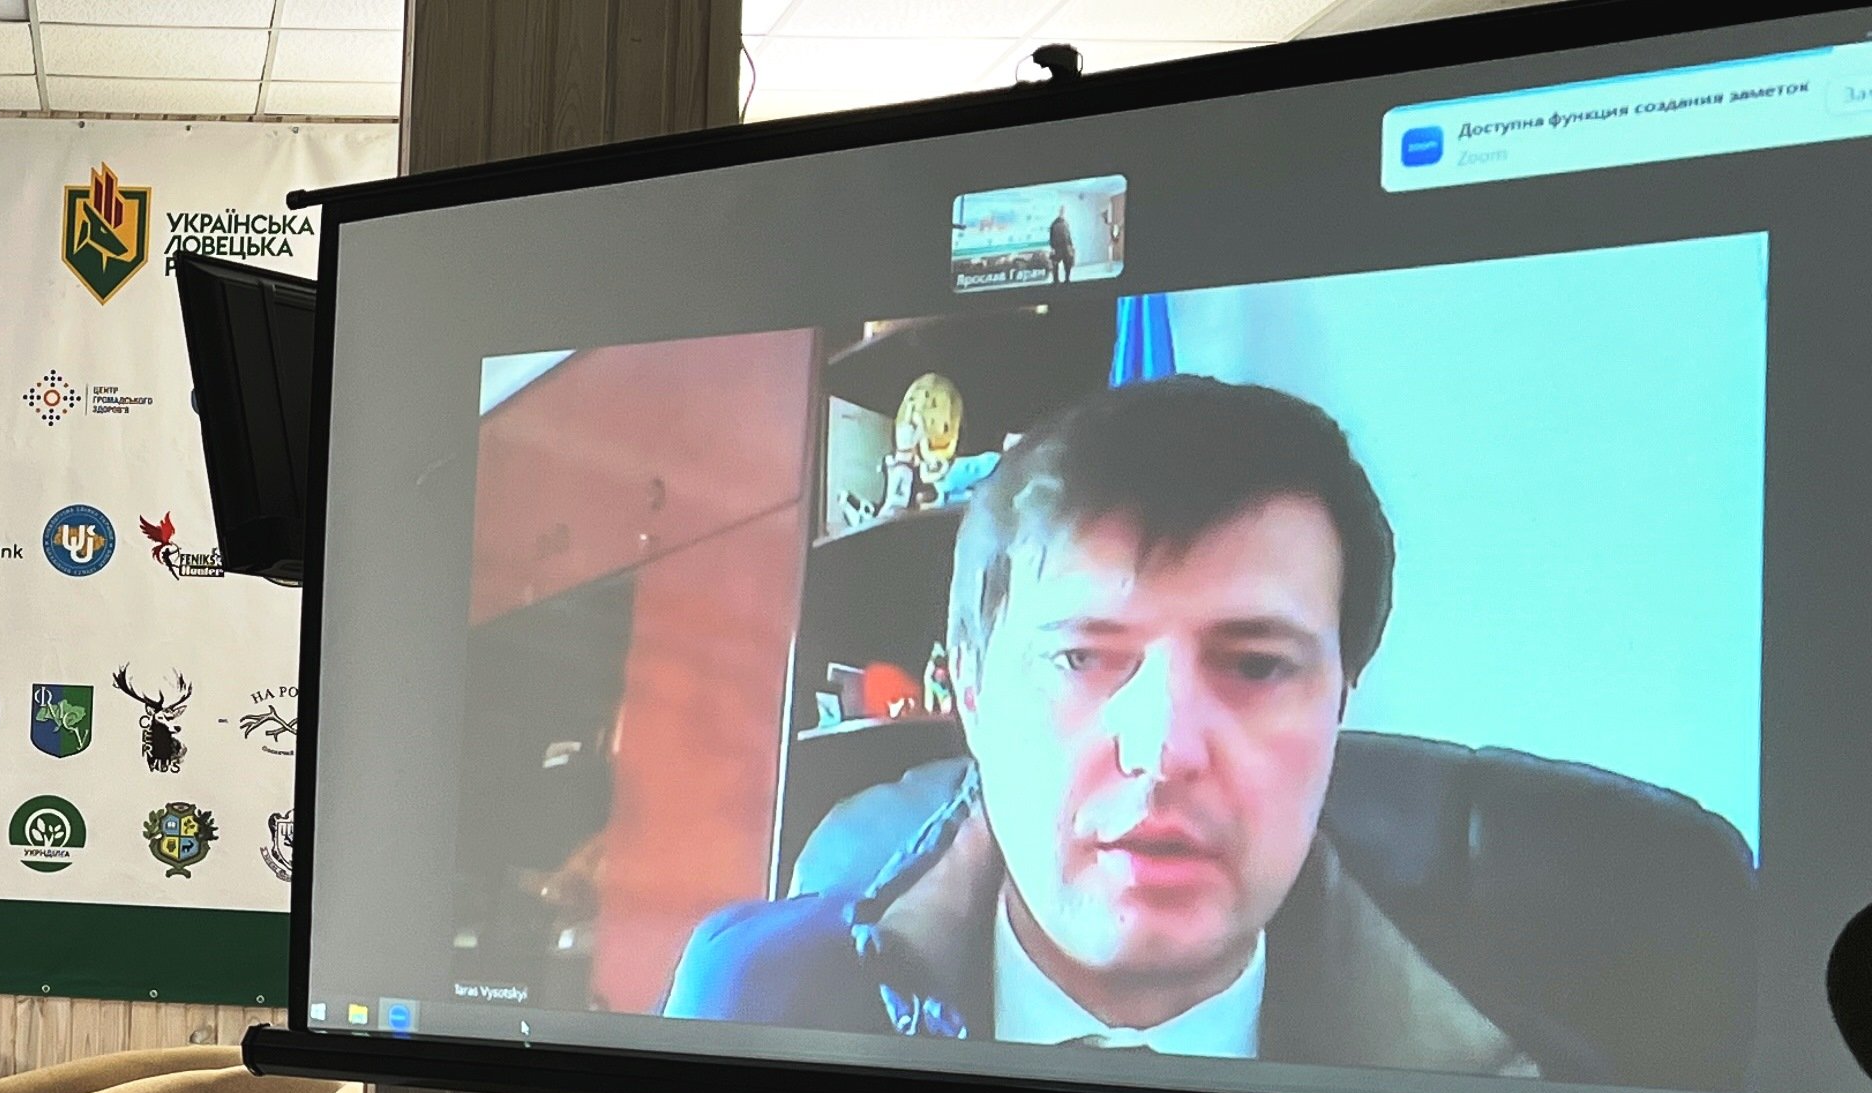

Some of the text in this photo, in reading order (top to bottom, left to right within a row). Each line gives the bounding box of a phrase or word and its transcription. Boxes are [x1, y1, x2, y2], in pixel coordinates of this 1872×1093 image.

[1458, 80, 1810, 140] Доступна функция создания заметок
[165, 208, 316, 236] УКРАЇНСЬКА
[163, 234, 295, 260] ЛОВЕЦЬКА
[279, 686, 300, 698] РО
